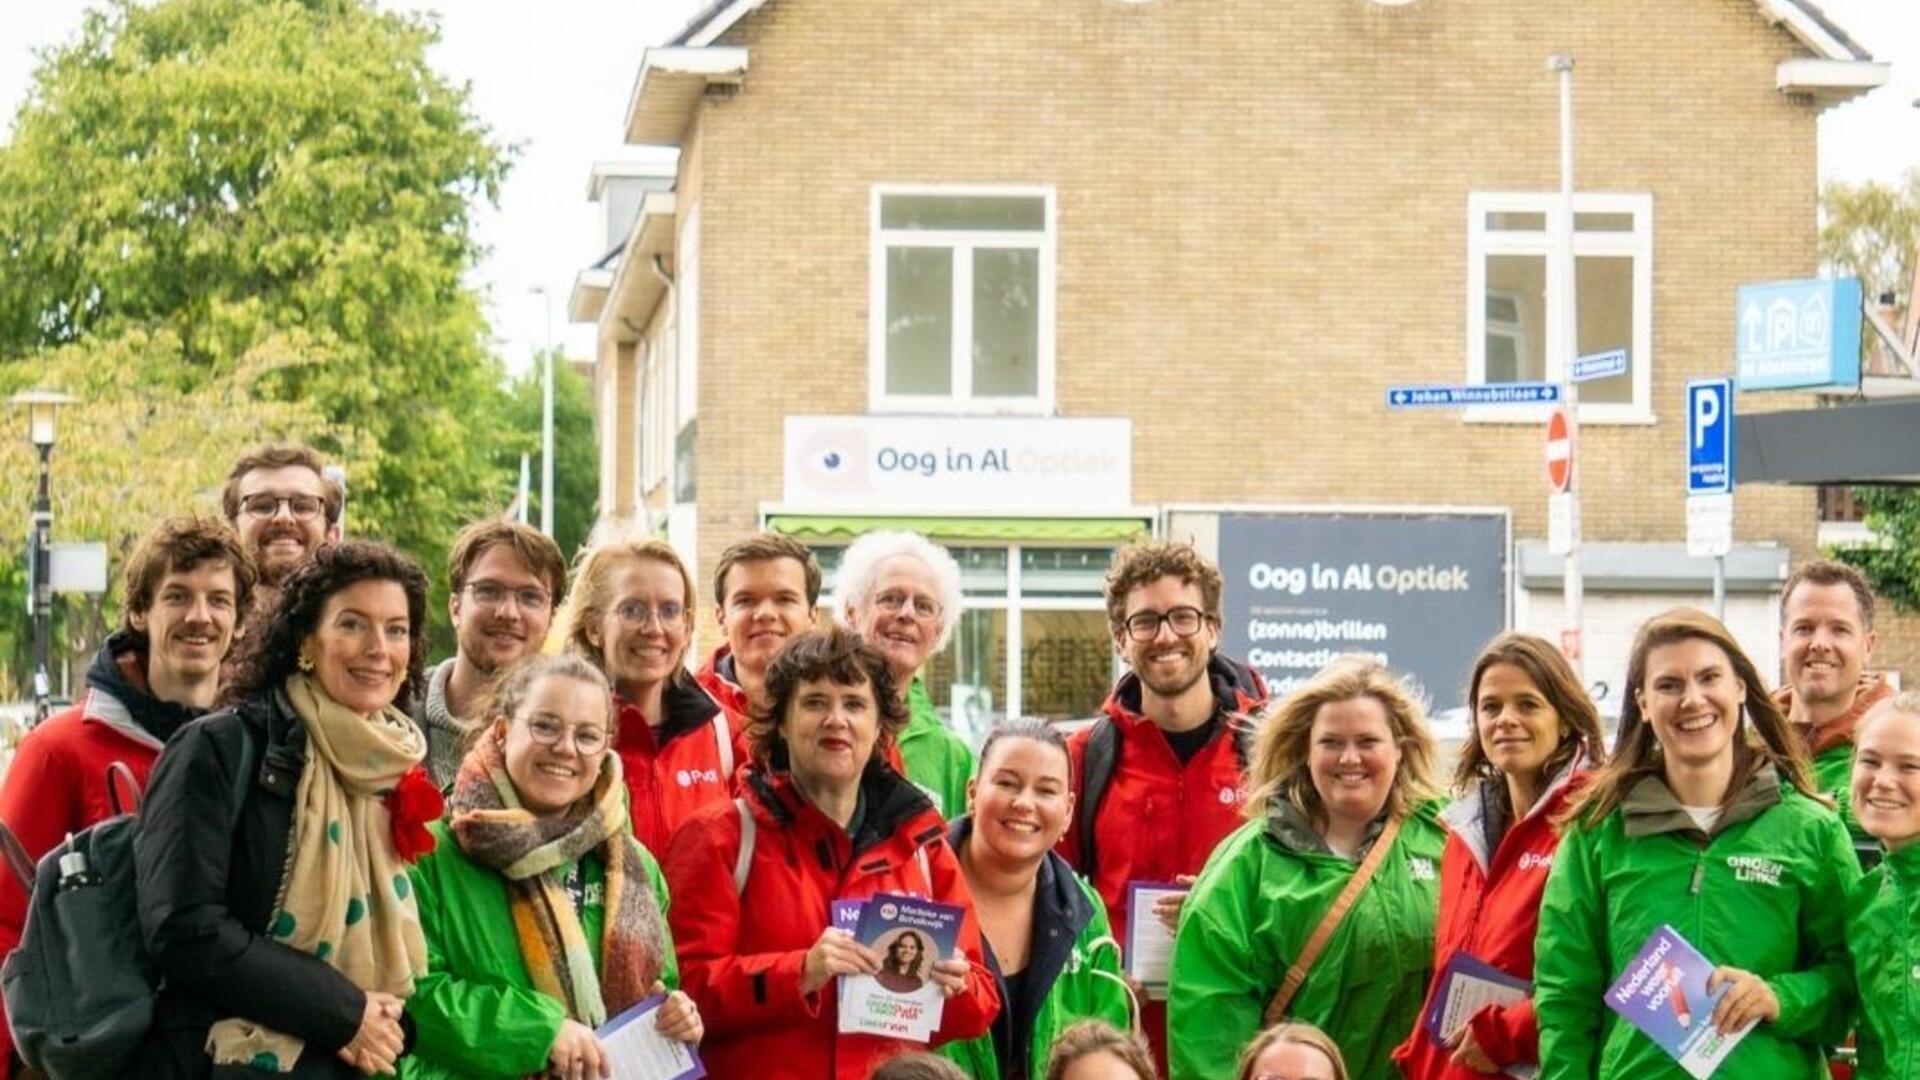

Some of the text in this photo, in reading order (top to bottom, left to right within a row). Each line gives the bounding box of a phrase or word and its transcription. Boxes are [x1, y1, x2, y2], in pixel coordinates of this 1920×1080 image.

[1695, 388, 1720, 448] P
[877, 448, 1118, 478] Oog in Al Optiek
[1249, 562, 1470, 595] Oog in Al Optiek
[1248, 618, 1387, 642] (zonne)brillen
[1615, 936, 1672, 1004] Nederland
